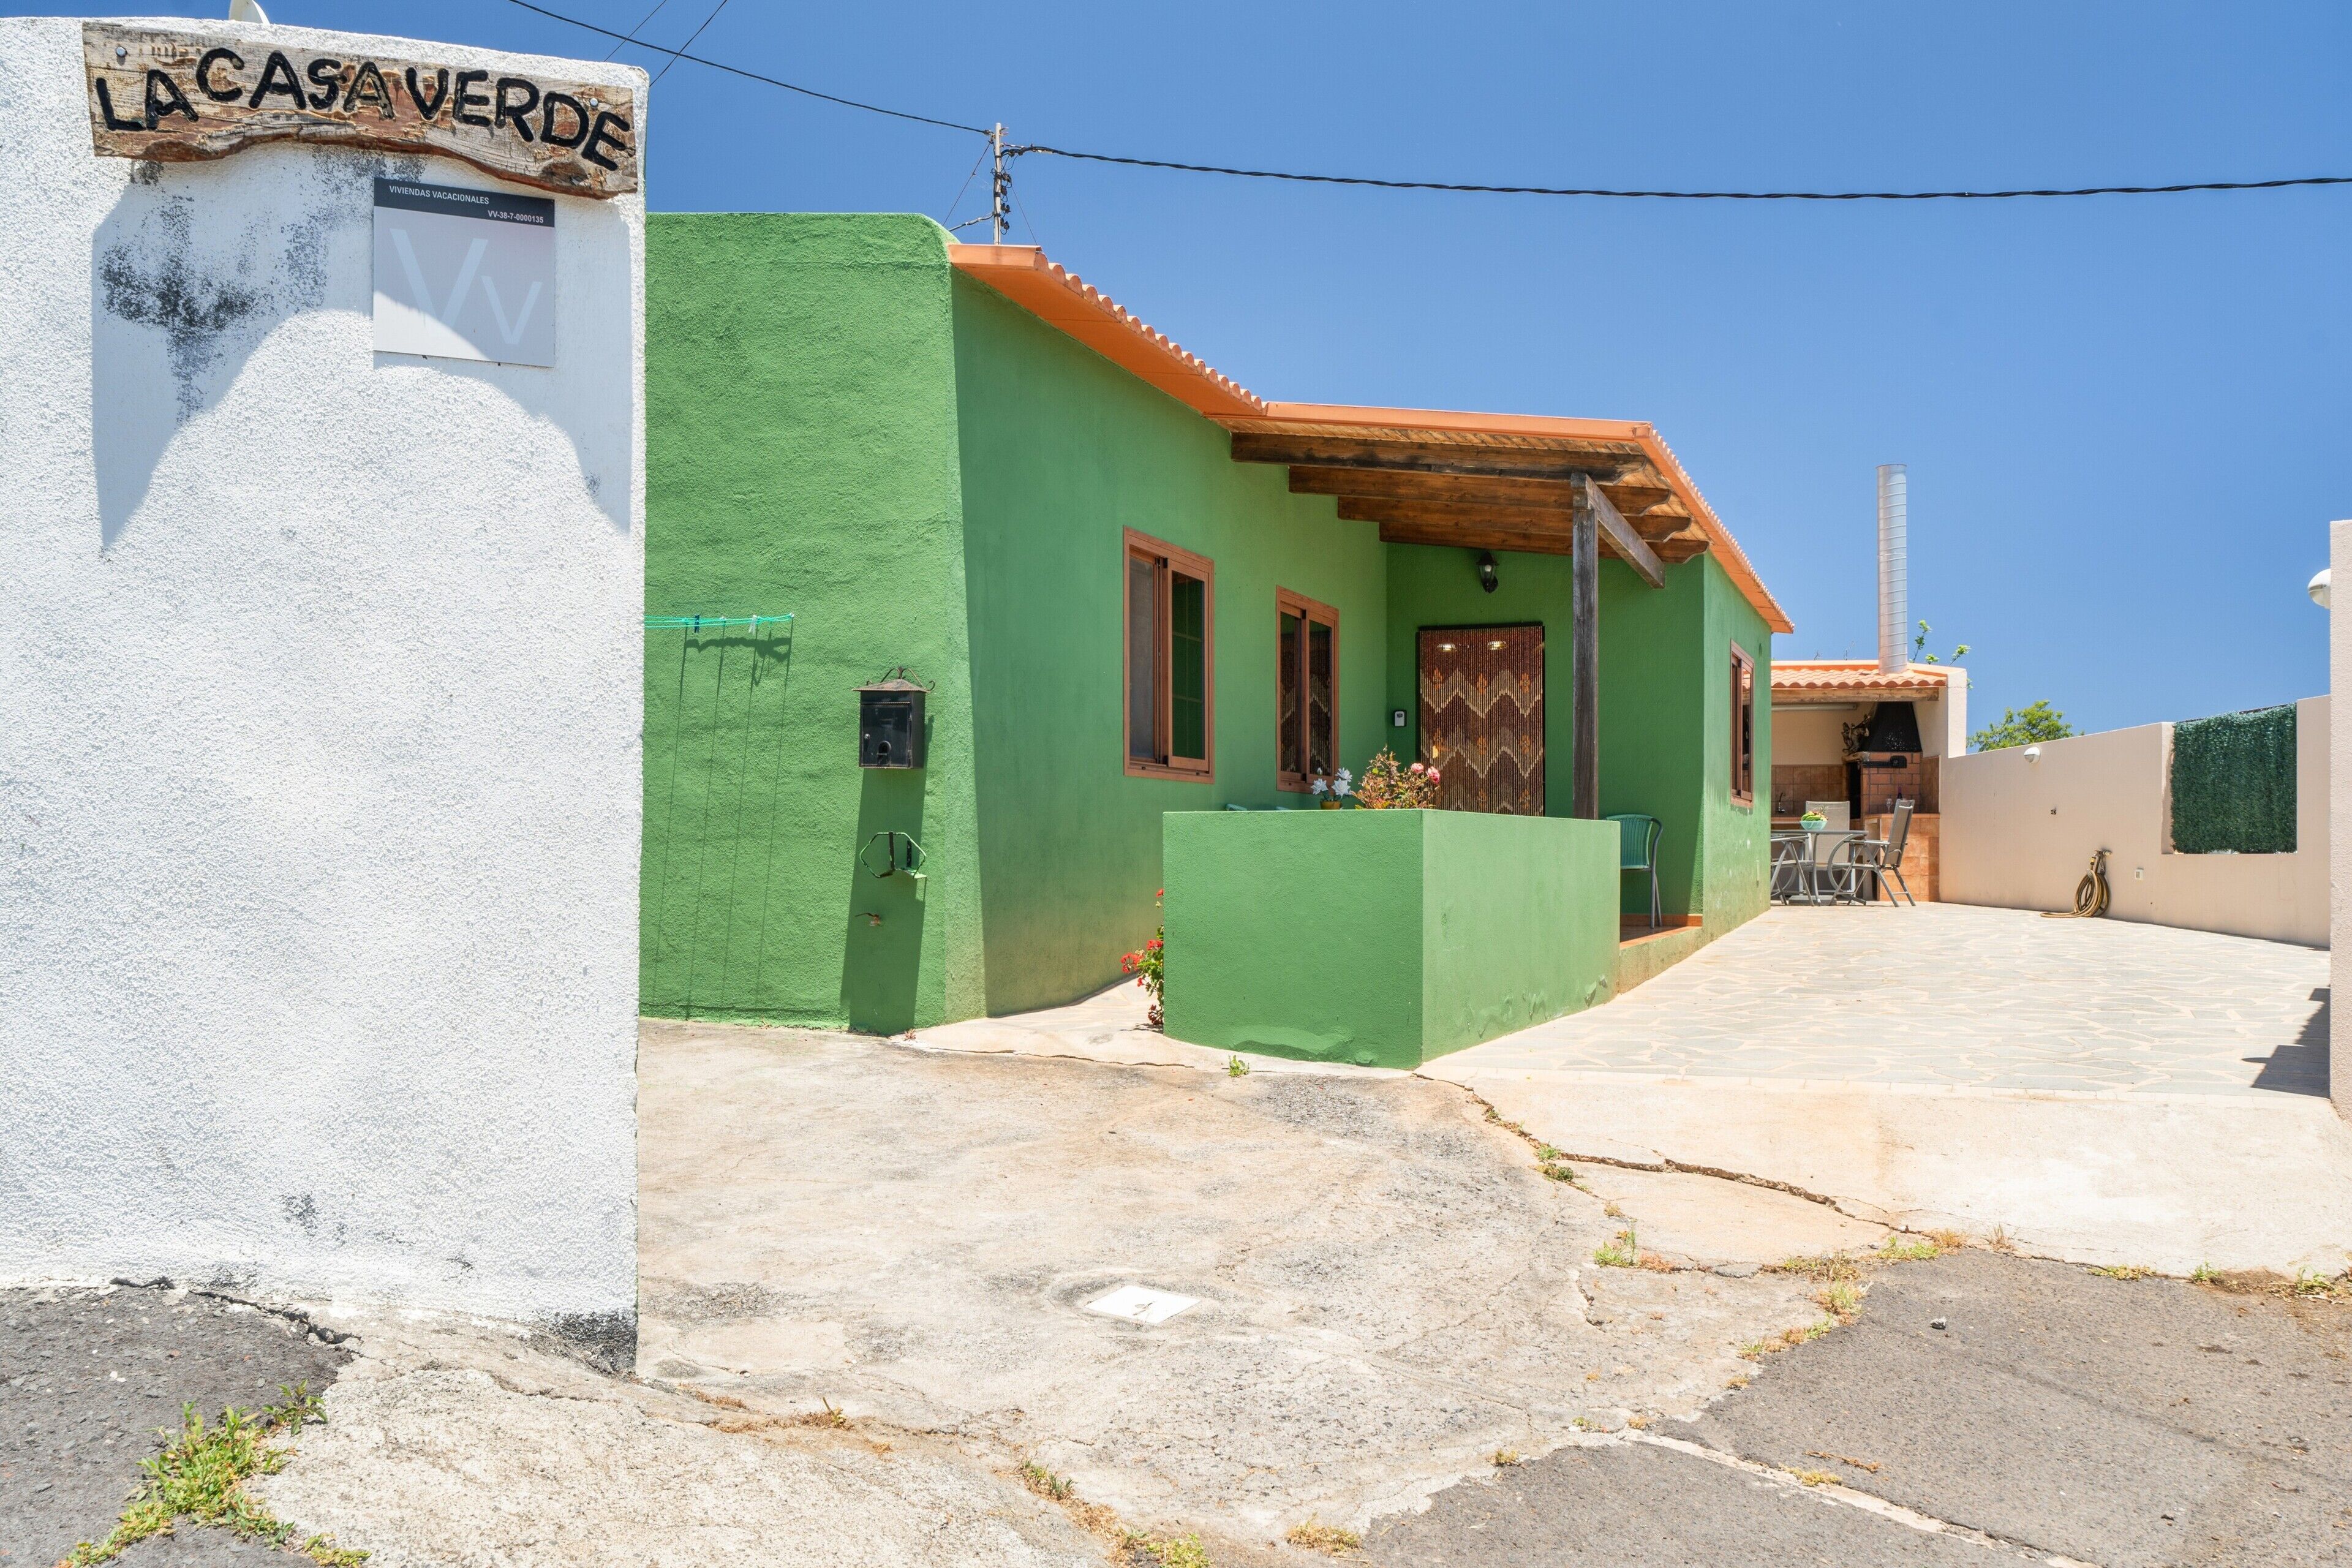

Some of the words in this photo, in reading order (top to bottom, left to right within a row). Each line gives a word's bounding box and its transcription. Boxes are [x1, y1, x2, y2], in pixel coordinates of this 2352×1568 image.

[96, 69, 198, 130] LA
[196, 48, 394, 119] CASA
[405, 66, 632, 171] VERDE
[389, 185, 431, 197] VIVIENDAS
[431, 190, 489, 205] VACACIONALES
[488, 209, 544, 224] VV-38-7-0000135
